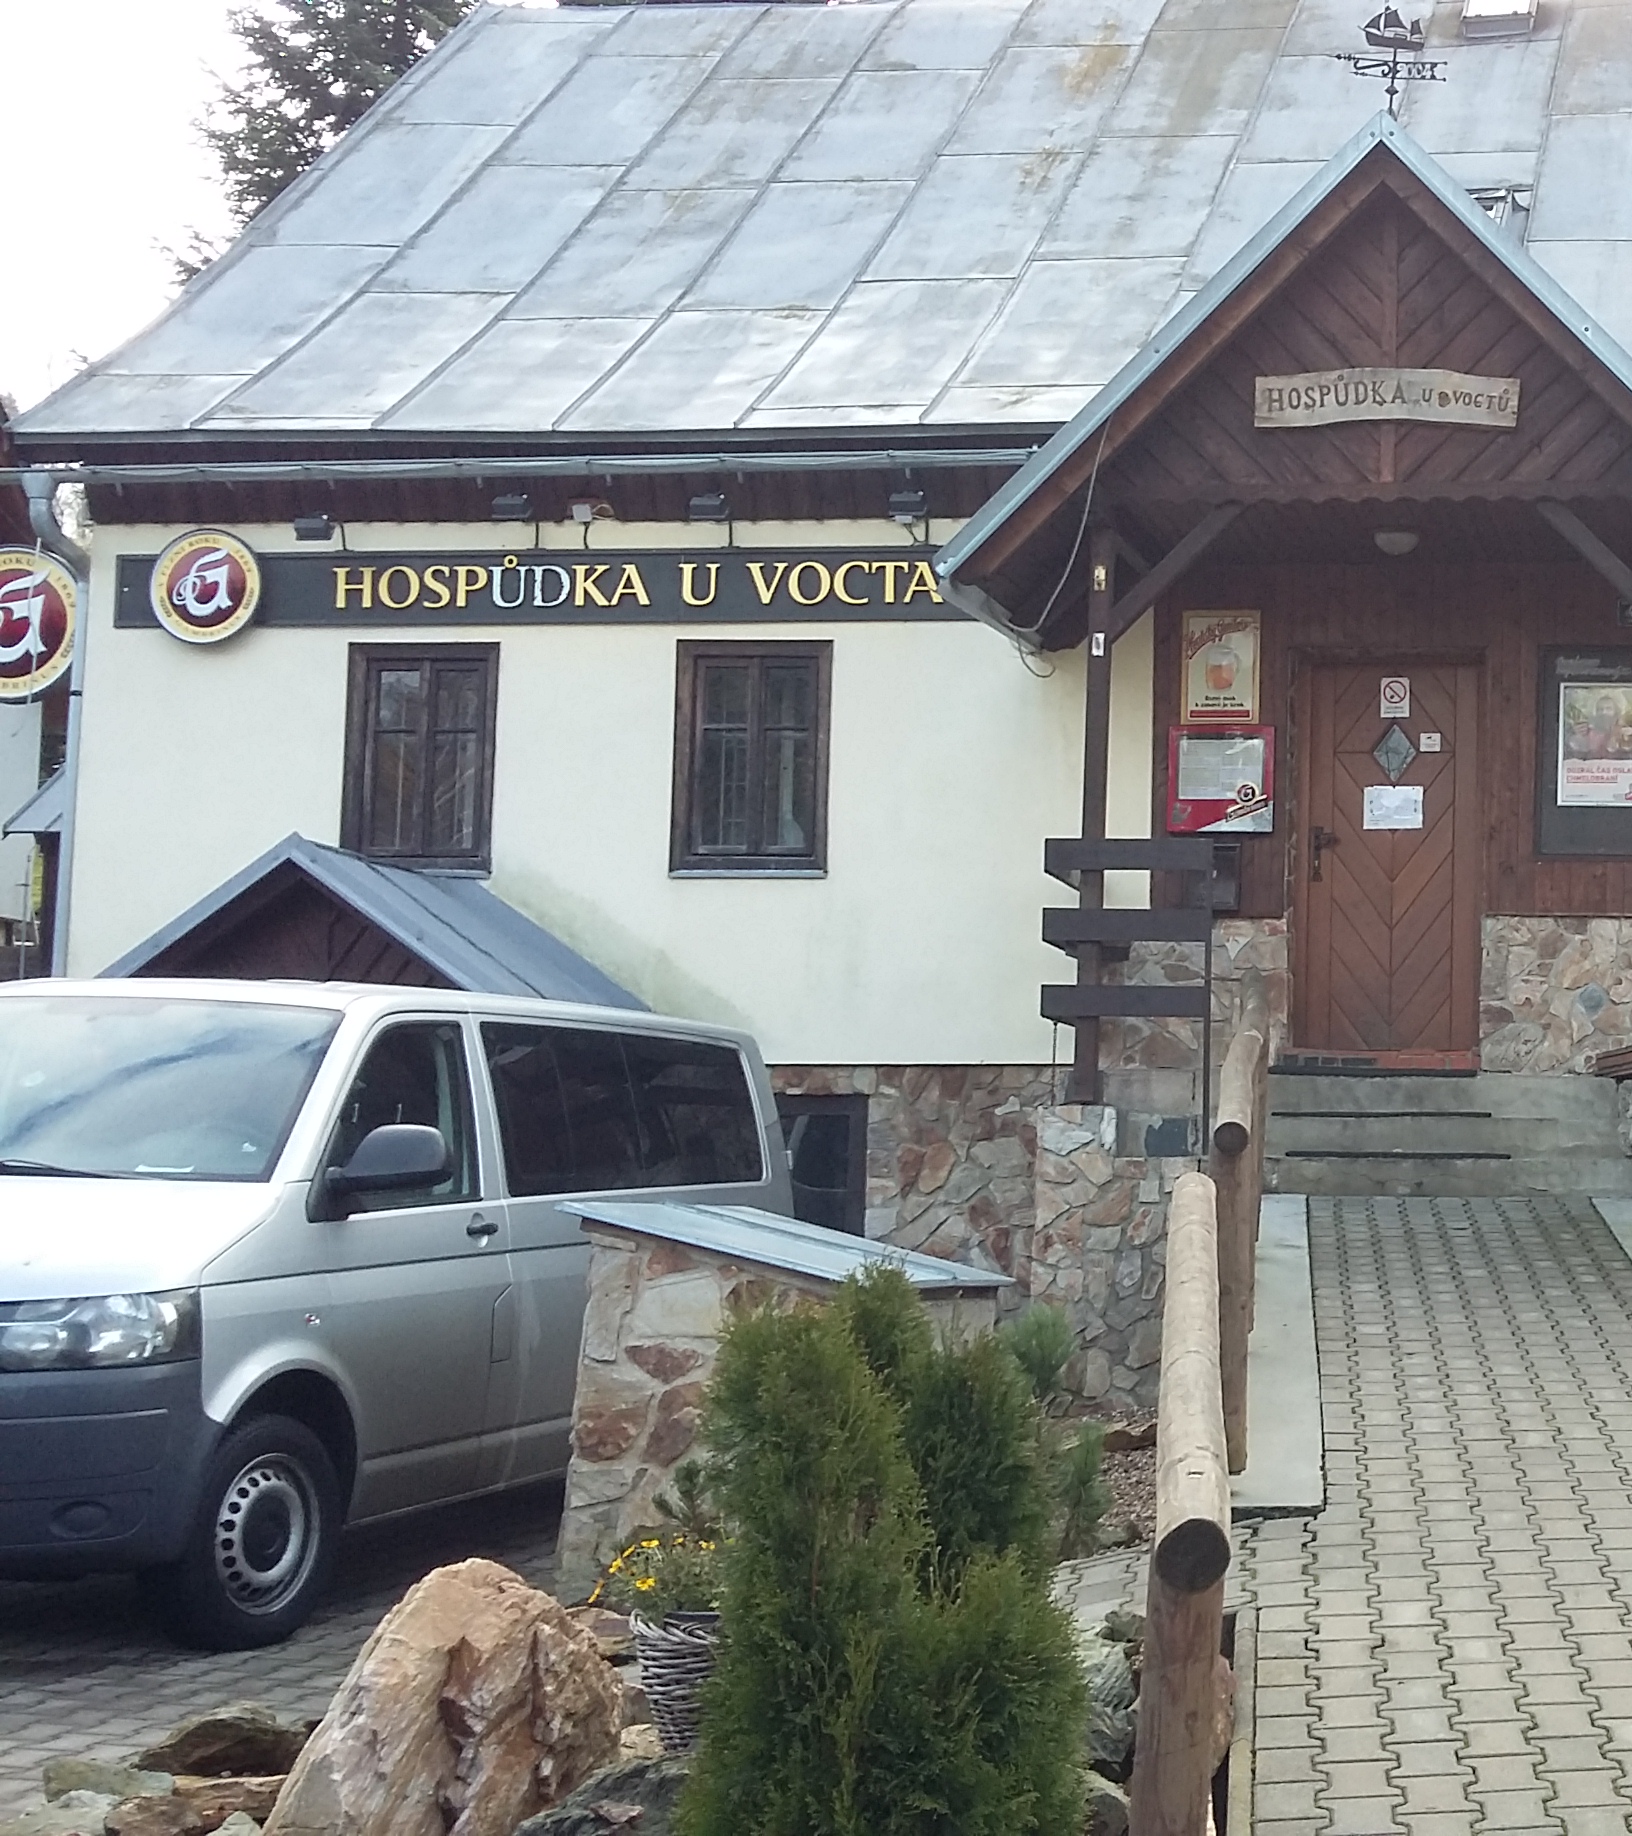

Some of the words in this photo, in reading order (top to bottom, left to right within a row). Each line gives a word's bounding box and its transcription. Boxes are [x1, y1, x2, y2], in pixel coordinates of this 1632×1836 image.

[1398, 63, 1432, 78] 2004
[1266, 374, 1408, 413] HOSPŮDKA
[1421, 388, 1433, 403] U
[332, 555, 651, 609] HOSPŮDKA
[678, 561, 720, 606] U
[746, 560, 945, 606] VOCTA
